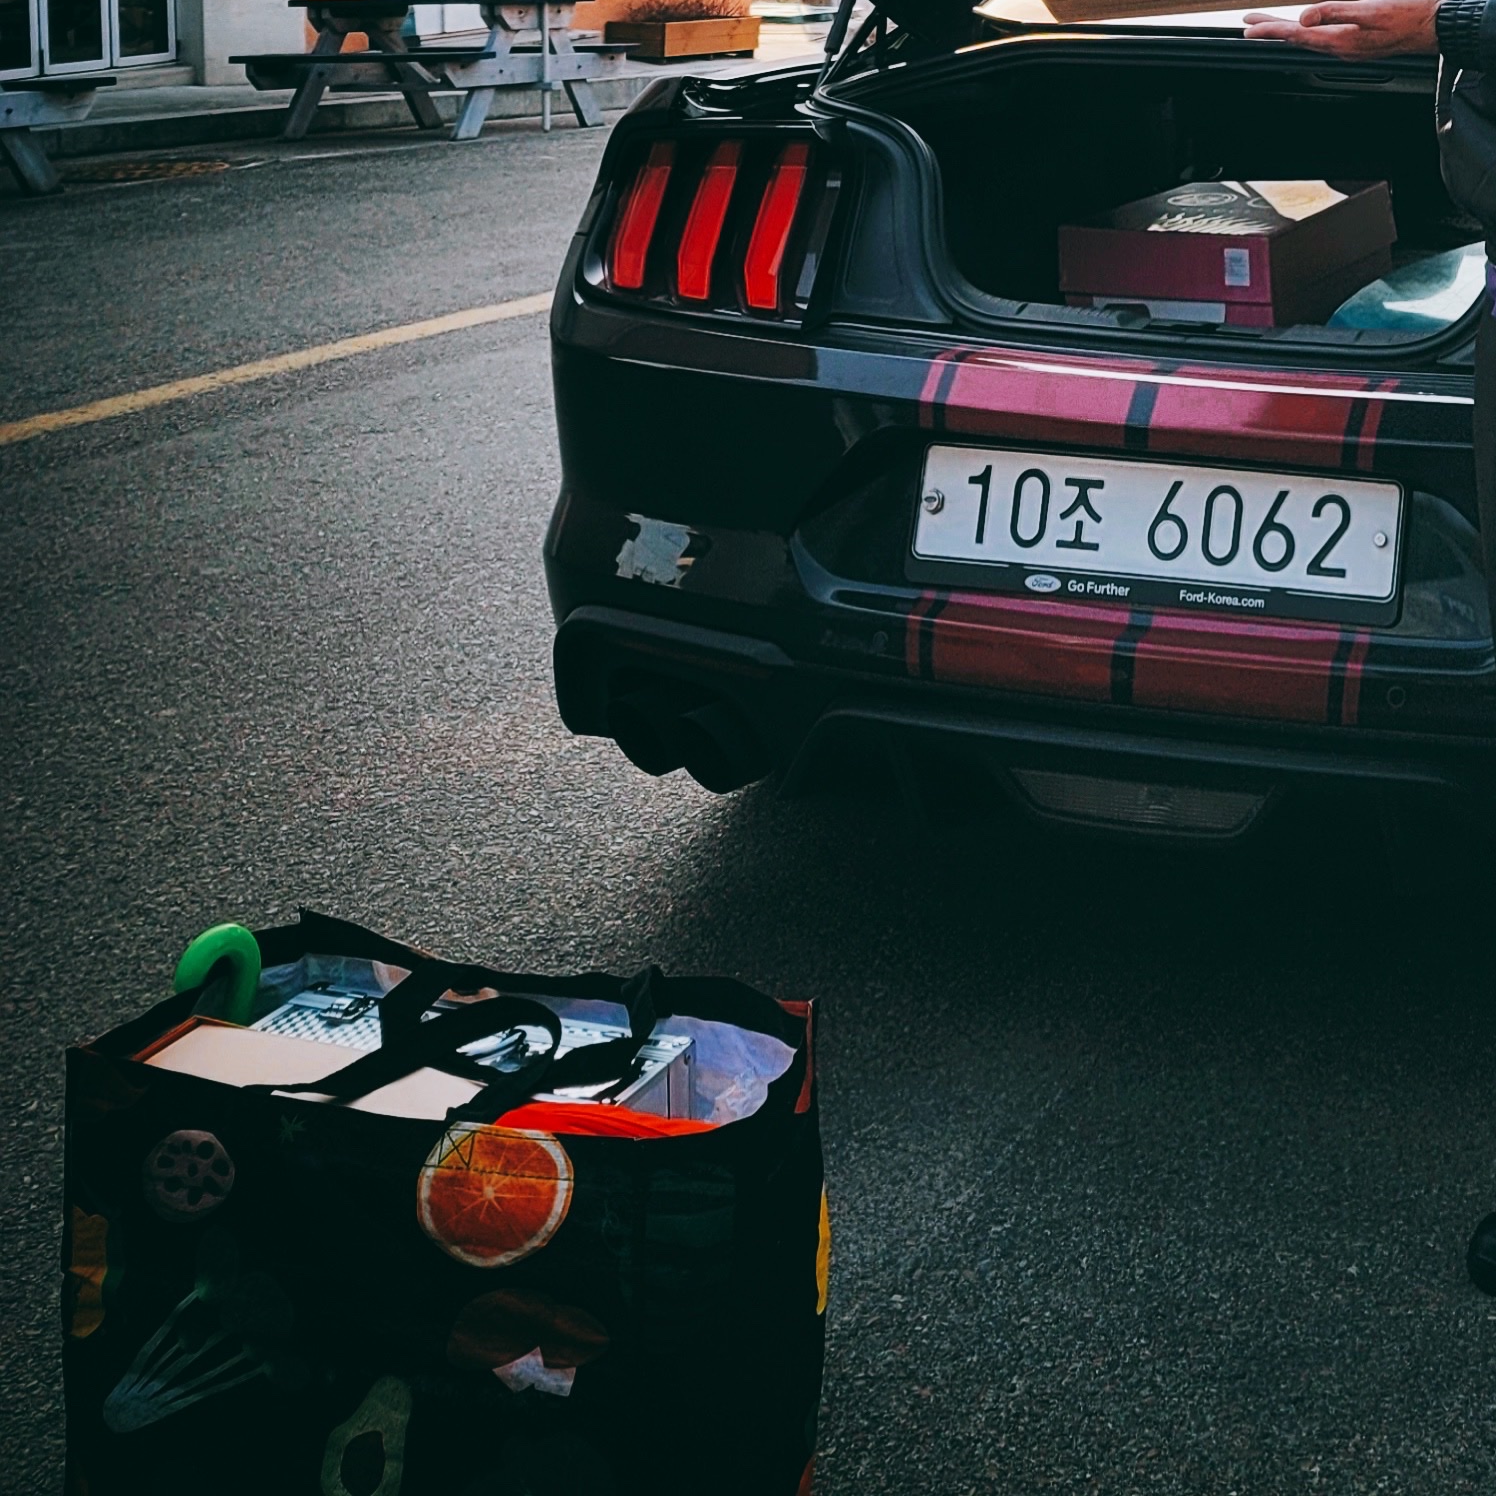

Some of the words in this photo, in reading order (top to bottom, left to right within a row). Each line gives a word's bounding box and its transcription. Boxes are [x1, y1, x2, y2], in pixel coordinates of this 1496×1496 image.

[966, 464, 1105, 552] 10조
[1146, 480, 1352, 578] 6062
[1067, 579, 1085, 593] Go
[1086, 581, 1131, 597] Further
[1179, 589, 1265, 609] Ford-Korea.com
